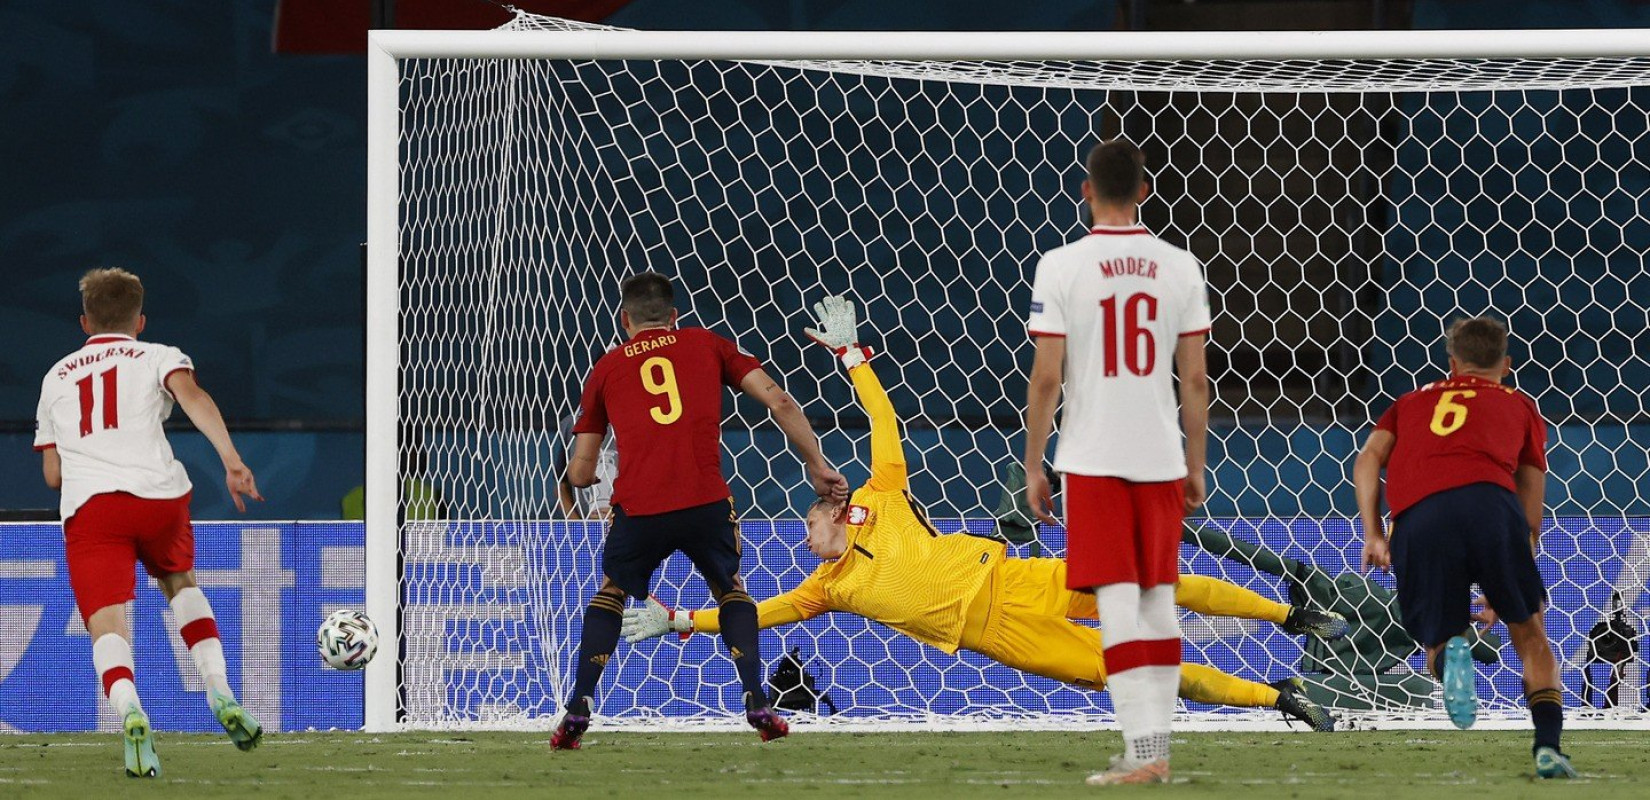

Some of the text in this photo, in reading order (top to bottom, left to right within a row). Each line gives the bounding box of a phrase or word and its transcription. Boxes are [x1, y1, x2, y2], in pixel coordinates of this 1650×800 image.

[1099, 256, 1158, 280] MODER
[624, 335, 677, 357] GERARD
[1099, 292, 1157, 377] 16
[75, 365, 118, 438] 11
[640, 356, 683, 425] 9
[1429, 389, 1477, 437] 6
